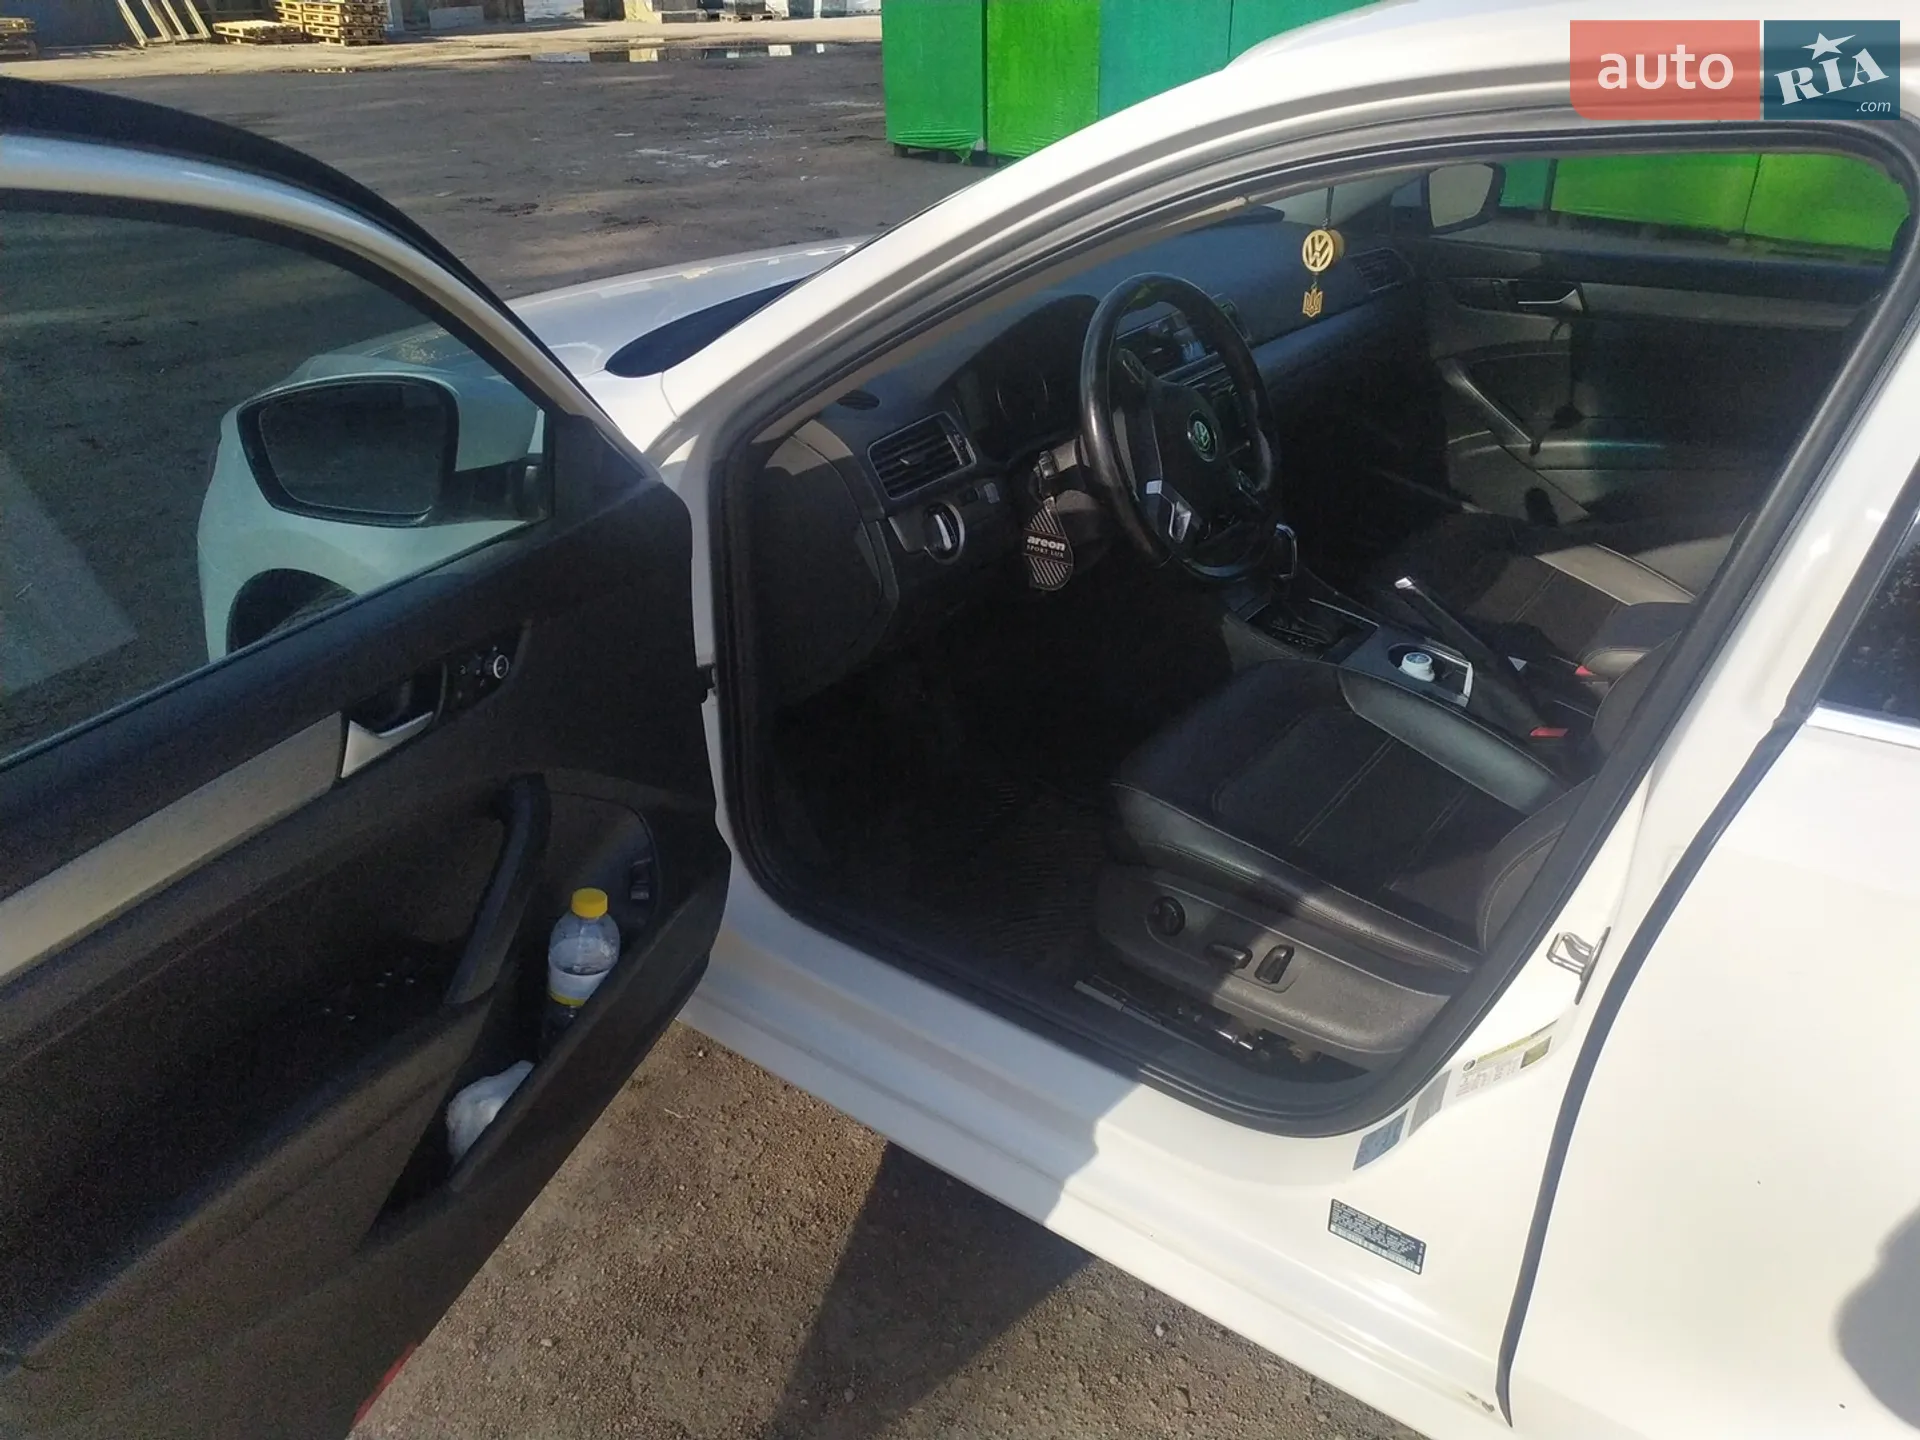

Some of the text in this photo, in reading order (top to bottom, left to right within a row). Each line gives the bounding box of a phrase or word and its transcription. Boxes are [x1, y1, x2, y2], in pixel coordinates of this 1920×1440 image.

[1027, 536, 1066, 551] areon
[1027, 544, 1064, 558] SPORT LUX
